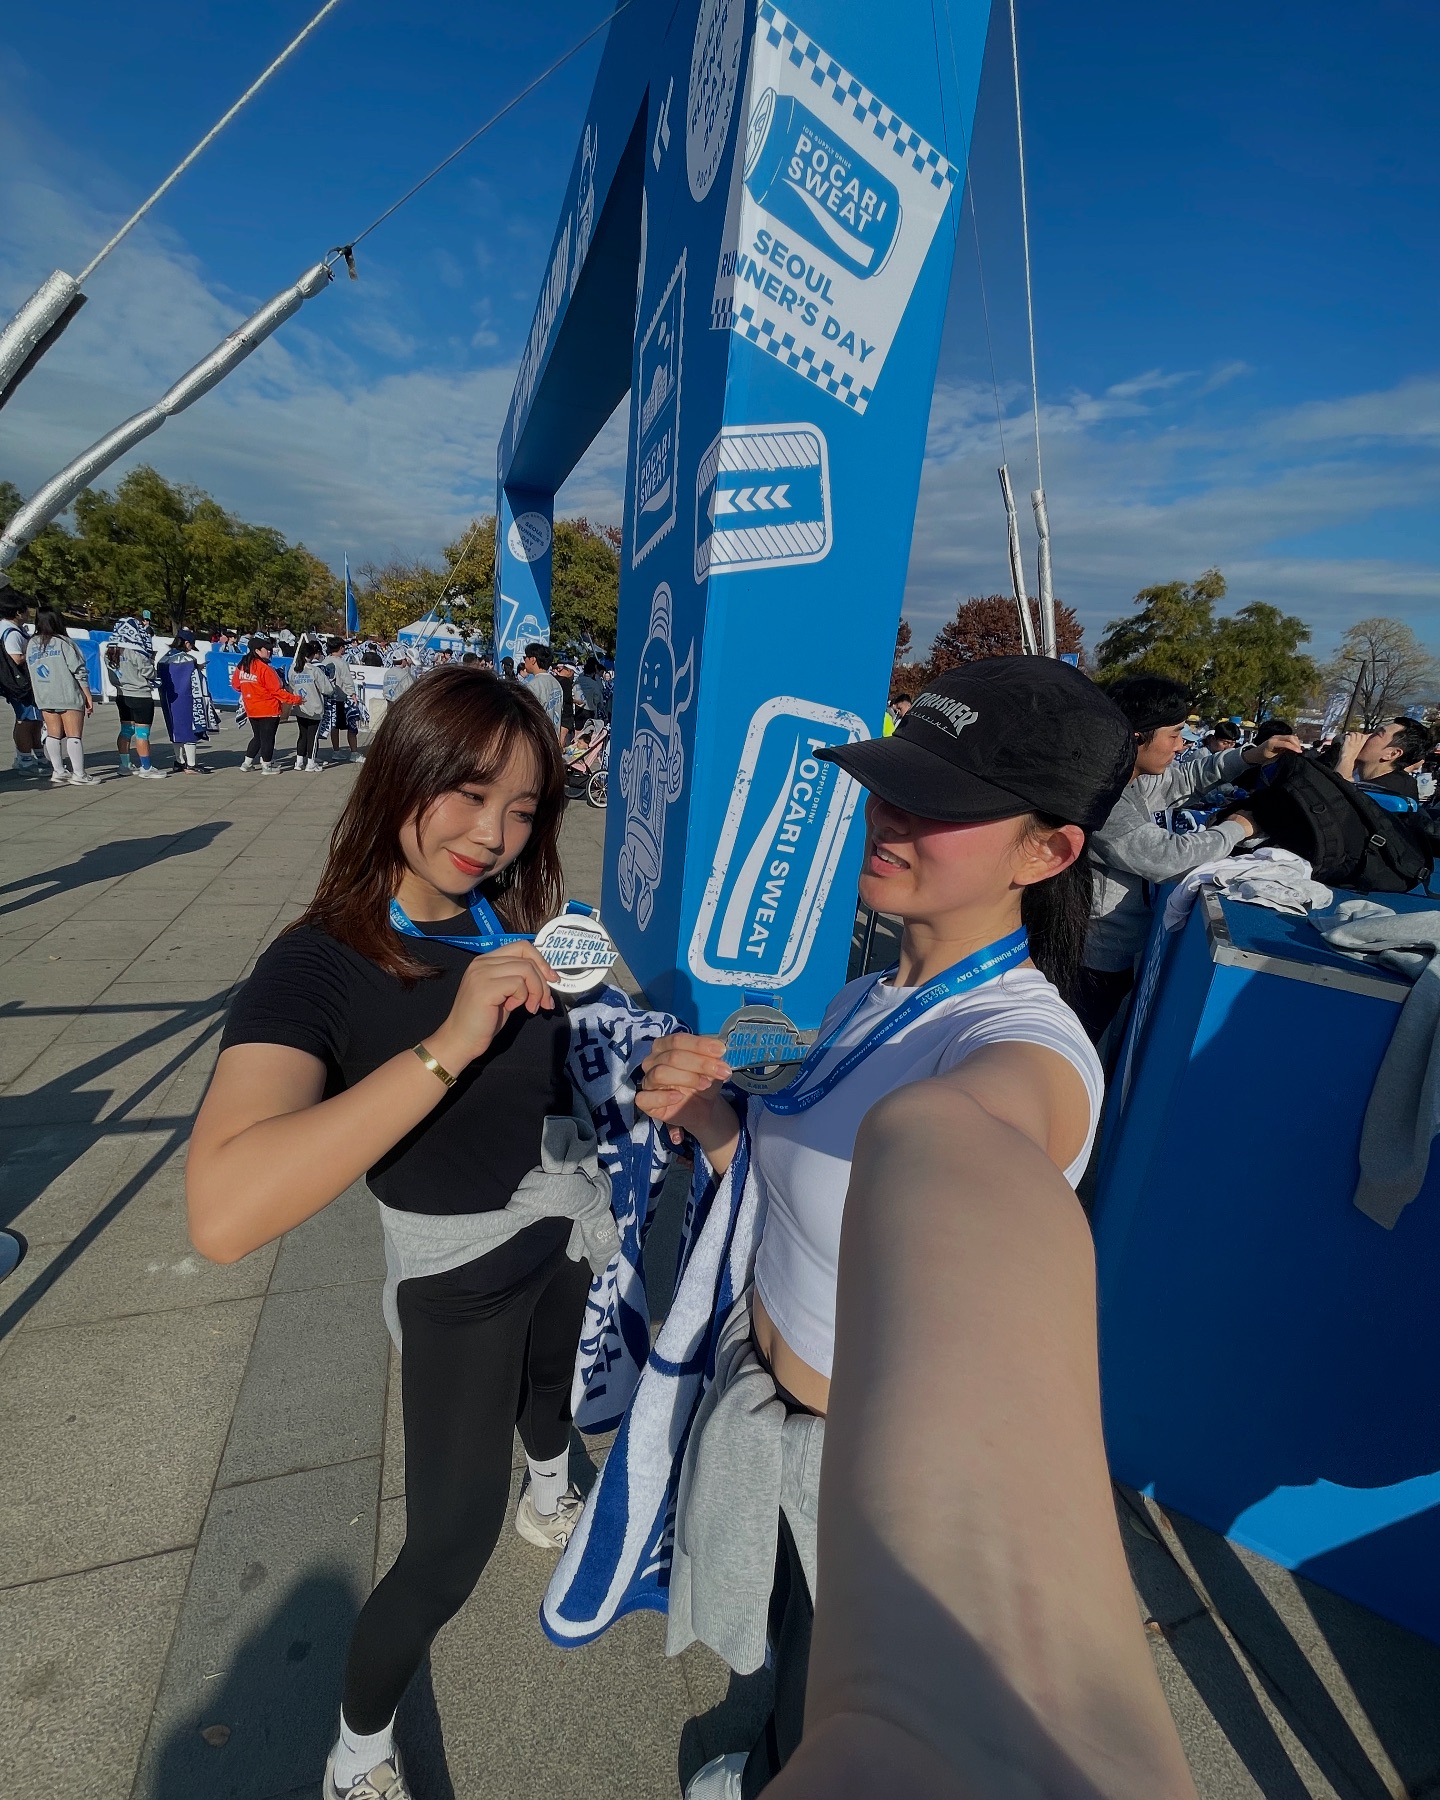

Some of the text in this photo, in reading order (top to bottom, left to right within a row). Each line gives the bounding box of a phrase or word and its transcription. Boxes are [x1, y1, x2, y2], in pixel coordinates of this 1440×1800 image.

[795, 133, 887, 222] POCARI
[788, 156, 872, 232] SWEAT
[752, 229, 834, 307] SEOUL
[720, 249, 876, 364] RUNNER'S DAY
[641, 427, 671, 488] POCARI
[640, 454, 667, 507] SWEAT
[525, 521, 543, 538] SEOUL
[521, 535, 534, 547] DAY
[911, 692, 979, 737] THRASHER
[807, 762, 830, 825] SUPPLY DRINK
[745, 863, 791, 959] SWEAT
[546, 936, 606, 952] 2024 SEOUL
[544, 950, 617, 967] NNER'S DAY
[973, 952, 1012, 974] RUNNER'S
[956, 971, 973, 984] DAY
[920, 986, 950, 1006] POCARI
[895, 1007, 912, 1023] 2024
[729, 1032, 794, 1046] 2024 SEOUL
[872, 1022, 894, 1041] SEOUL
[781, 1045, 809, 1061] DAY
